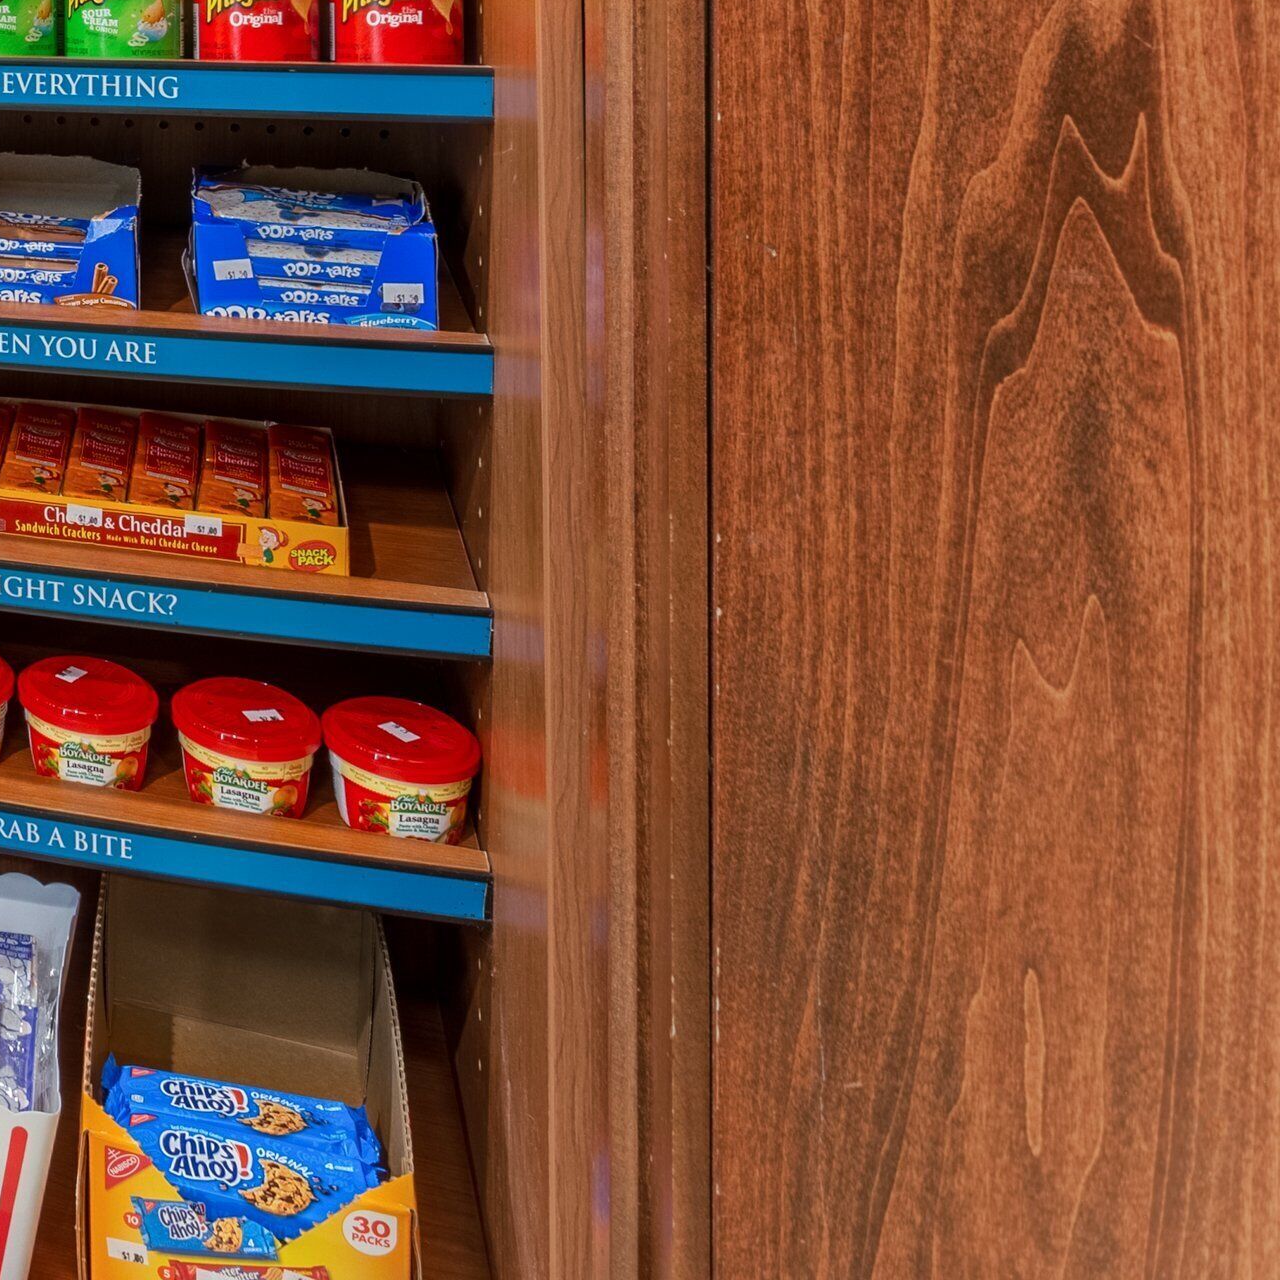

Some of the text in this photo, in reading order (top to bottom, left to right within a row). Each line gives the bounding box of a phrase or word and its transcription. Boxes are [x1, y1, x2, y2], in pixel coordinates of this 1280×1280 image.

[2, 73, 179, 100] EVERYTHING
[361, 315, 418, 328] Blueberry
[39, 335, 99, 362] YOU
[104, 340, 157, 365] ARE
[104, 515, 189, 539] & Cheddar
[297, 554, 334, 566] PACK
[73, 587, 178, 616] SNACK?
[58, 746, 113, 766] BOYARDEE
[66, 759, 105, 776] Lasagna
[47, 825, 66, 848] A
[74, 831, 133, 859] BITE
[161, 1079, 231, 1100] Chips
[250, 1091, 305, 1112] ORIGINAL
[109, 1157, 138, 1175] NABISCO
[126, 1214, 139, 1225] 10
[352, 1215, 391, 1237] 30
[352, 1233, 391, 1248] PACKS
